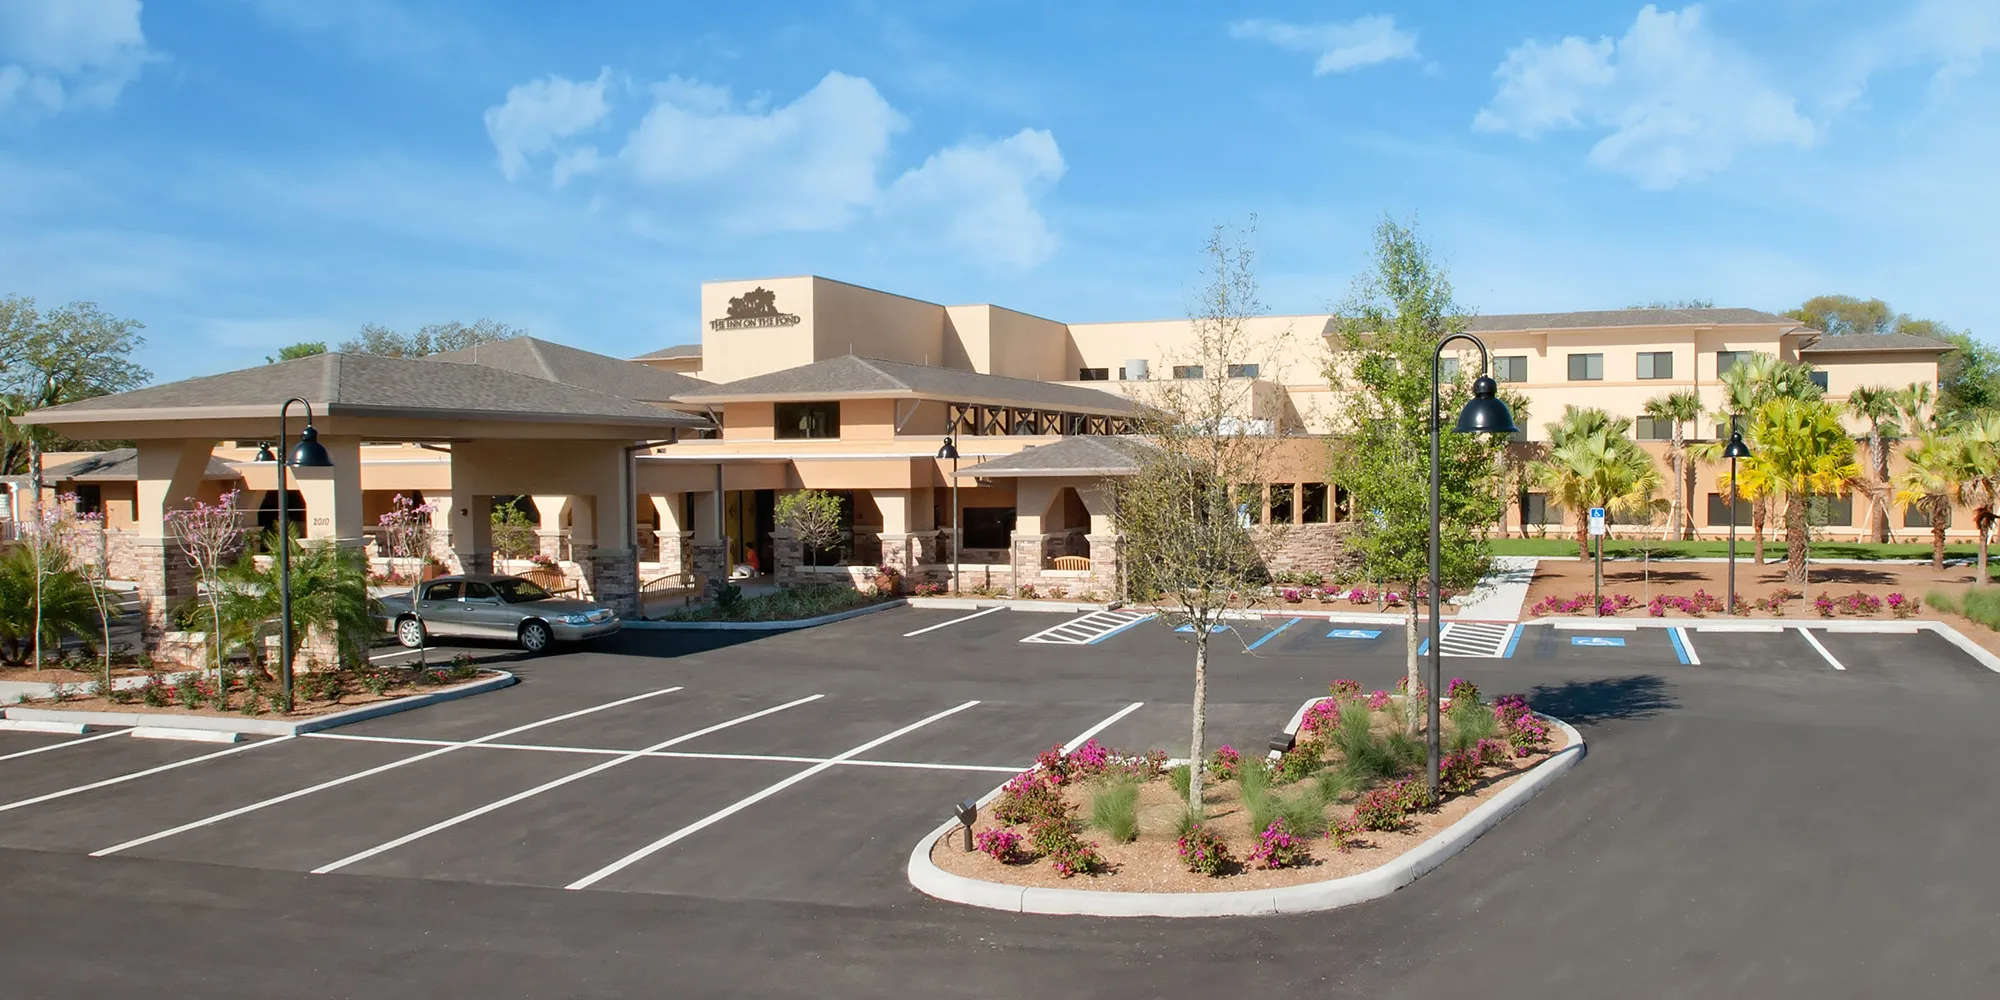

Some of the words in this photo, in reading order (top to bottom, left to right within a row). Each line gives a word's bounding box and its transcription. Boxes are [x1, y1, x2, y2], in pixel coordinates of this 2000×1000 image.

[709, 319, 725, 331] THE
[726, 319, 742, 329] INN
[743, 318, 757, 328] ON
[759, 317, 774, 327] THE
[775, 315, 801, 327] POND
[313, 517, 330, 526] 2010
